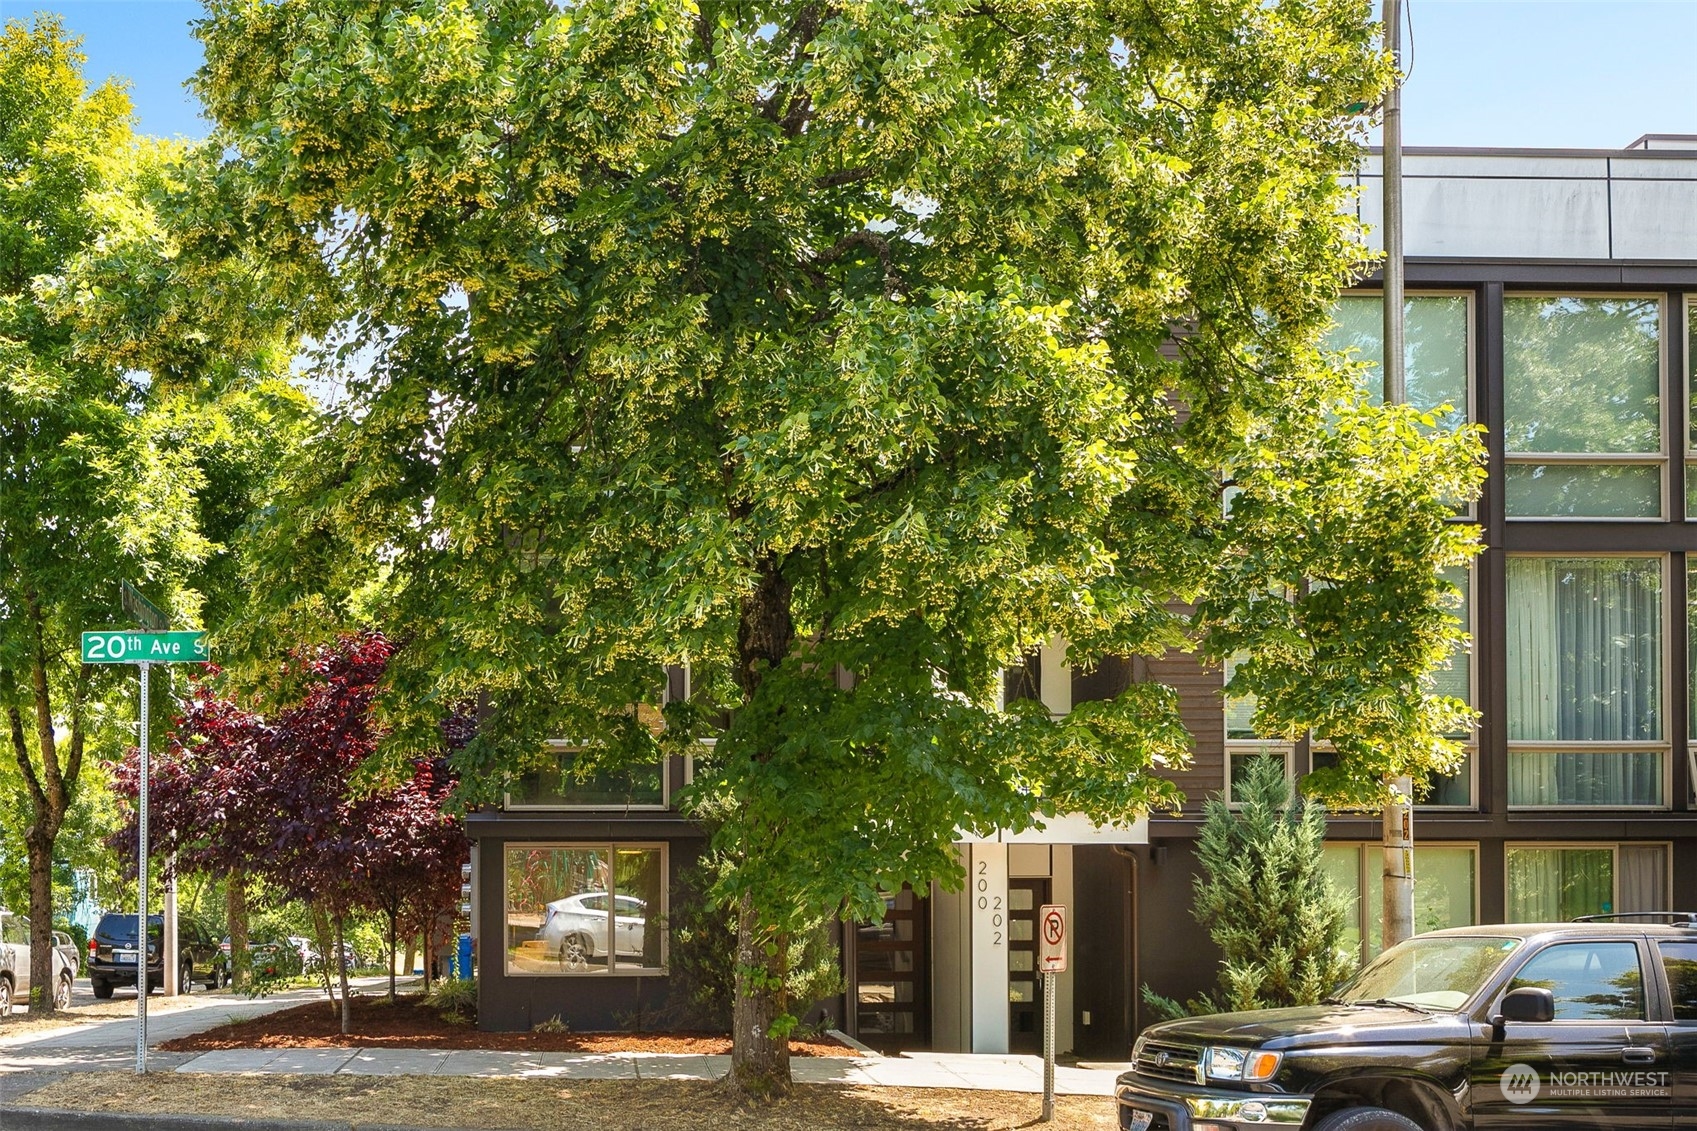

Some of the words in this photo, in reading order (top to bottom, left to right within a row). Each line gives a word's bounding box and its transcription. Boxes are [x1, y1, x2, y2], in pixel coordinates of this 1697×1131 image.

[87, 636, 142, 658] 20th
[151, 640, 180, 654] Ave
[194, 640, 204, 654] S
